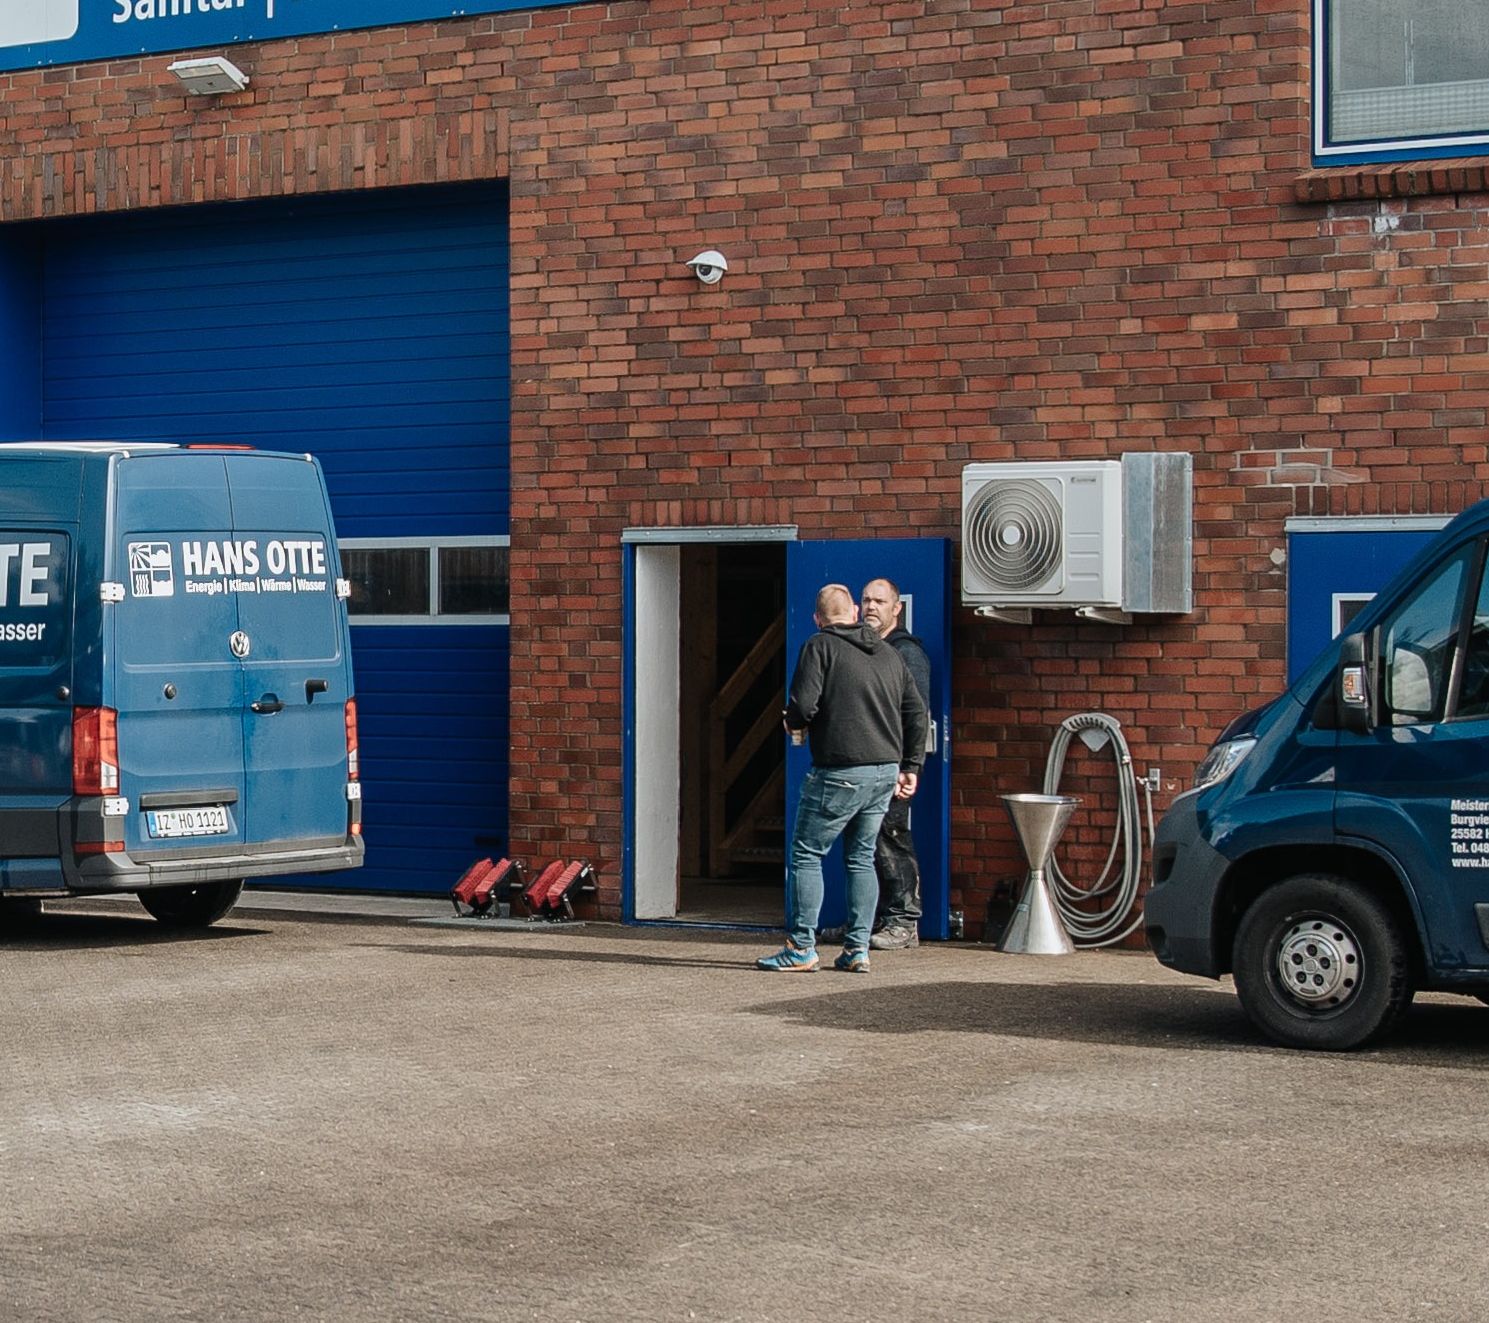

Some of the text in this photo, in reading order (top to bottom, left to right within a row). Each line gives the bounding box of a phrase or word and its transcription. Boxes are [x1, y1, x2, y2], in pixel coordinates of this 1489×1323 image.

[183, 541, 326, 576] HANS OTTE
[186, 580, 222, 595] Energie
[229, 579, 255, 592] Klima
[262, 578, 292, 592] Wärme
[298, 580, 326, 591] Wasser
[157, 811, 225, 830] IZ HO 1121
[1451, 828, 1483, 839] 25582
[1452, 842, 1469, 853] Tel.
